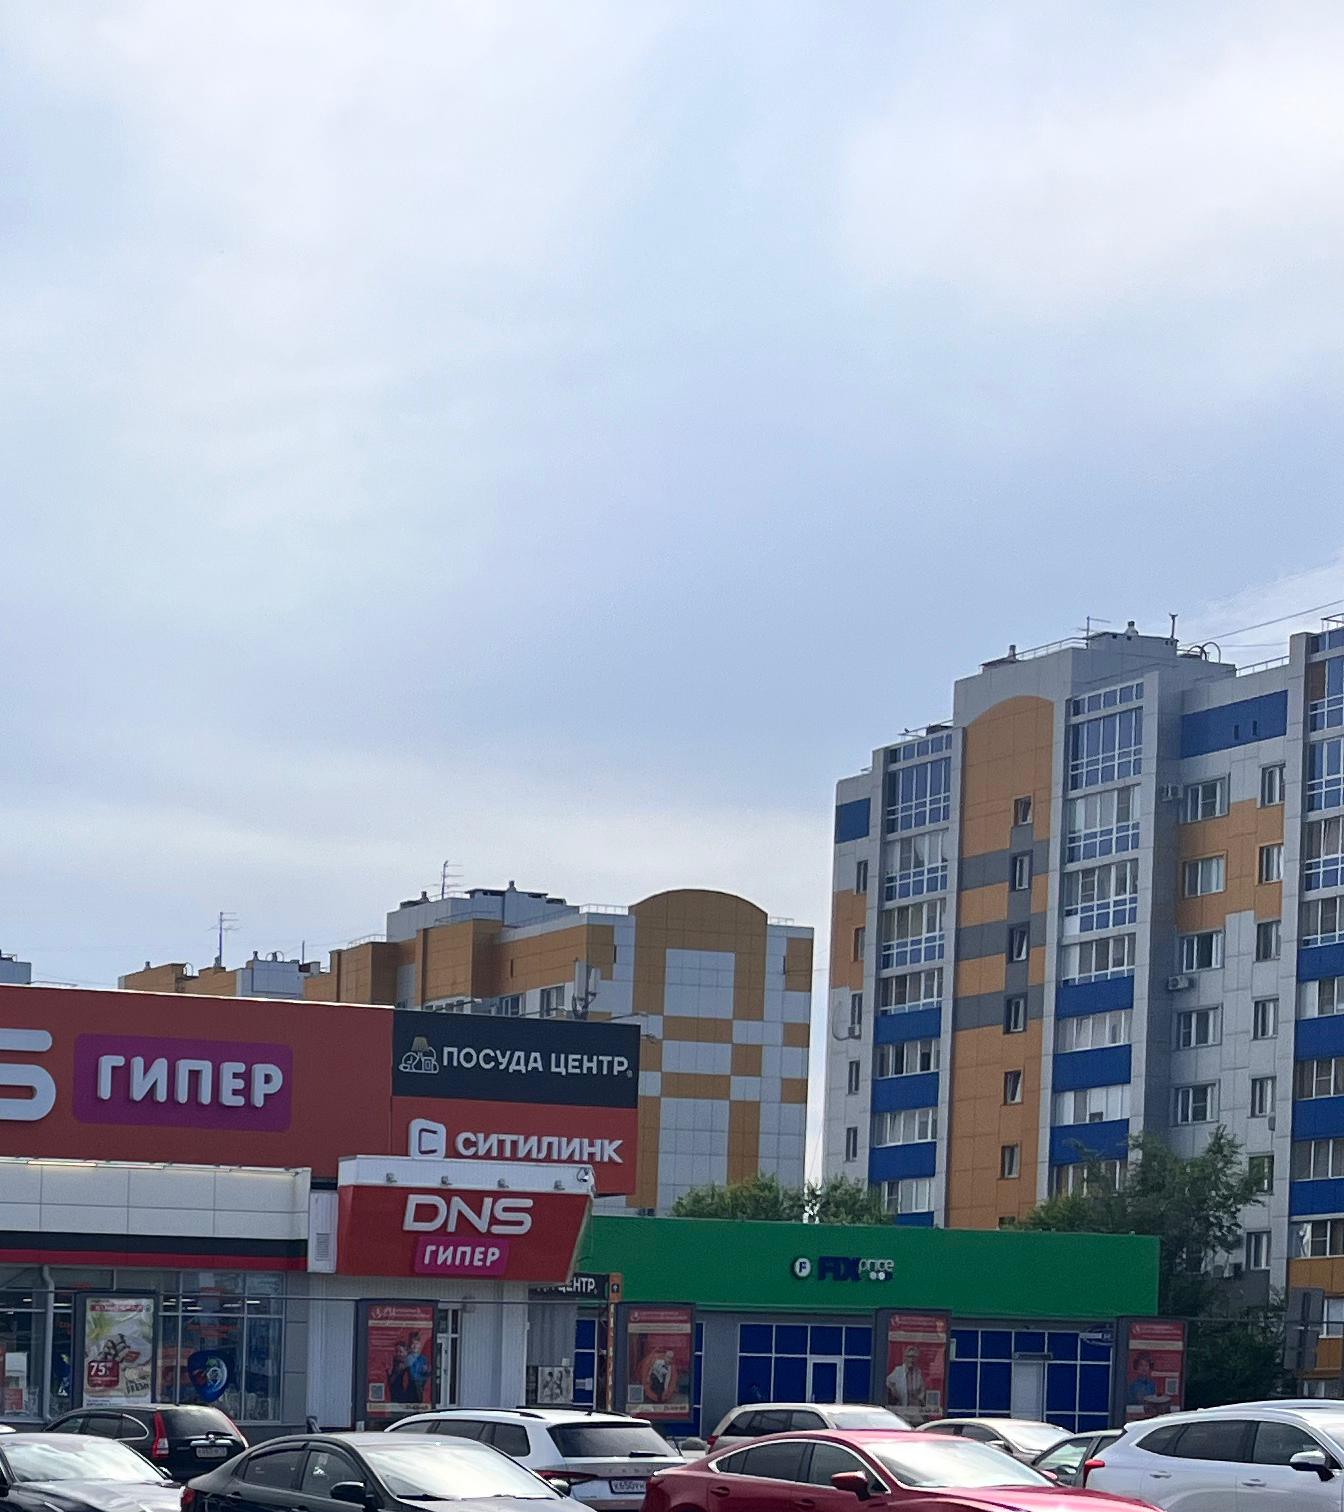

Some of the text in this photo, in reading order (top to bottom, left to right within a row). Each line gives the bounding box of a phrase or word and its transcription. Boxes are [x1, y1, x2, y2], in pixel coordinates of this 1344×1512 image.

[442, 1046, 630, 1076] ПОСУДА ЦЕНТР
[97, 1054, 285, 1109] ГИПЕР
[455, 1131, 625, 1164] СИТИЛИНК
[402, 1193, 534, 1235] DNS
[423, 1244, 501, 1267] ГИПЕР
